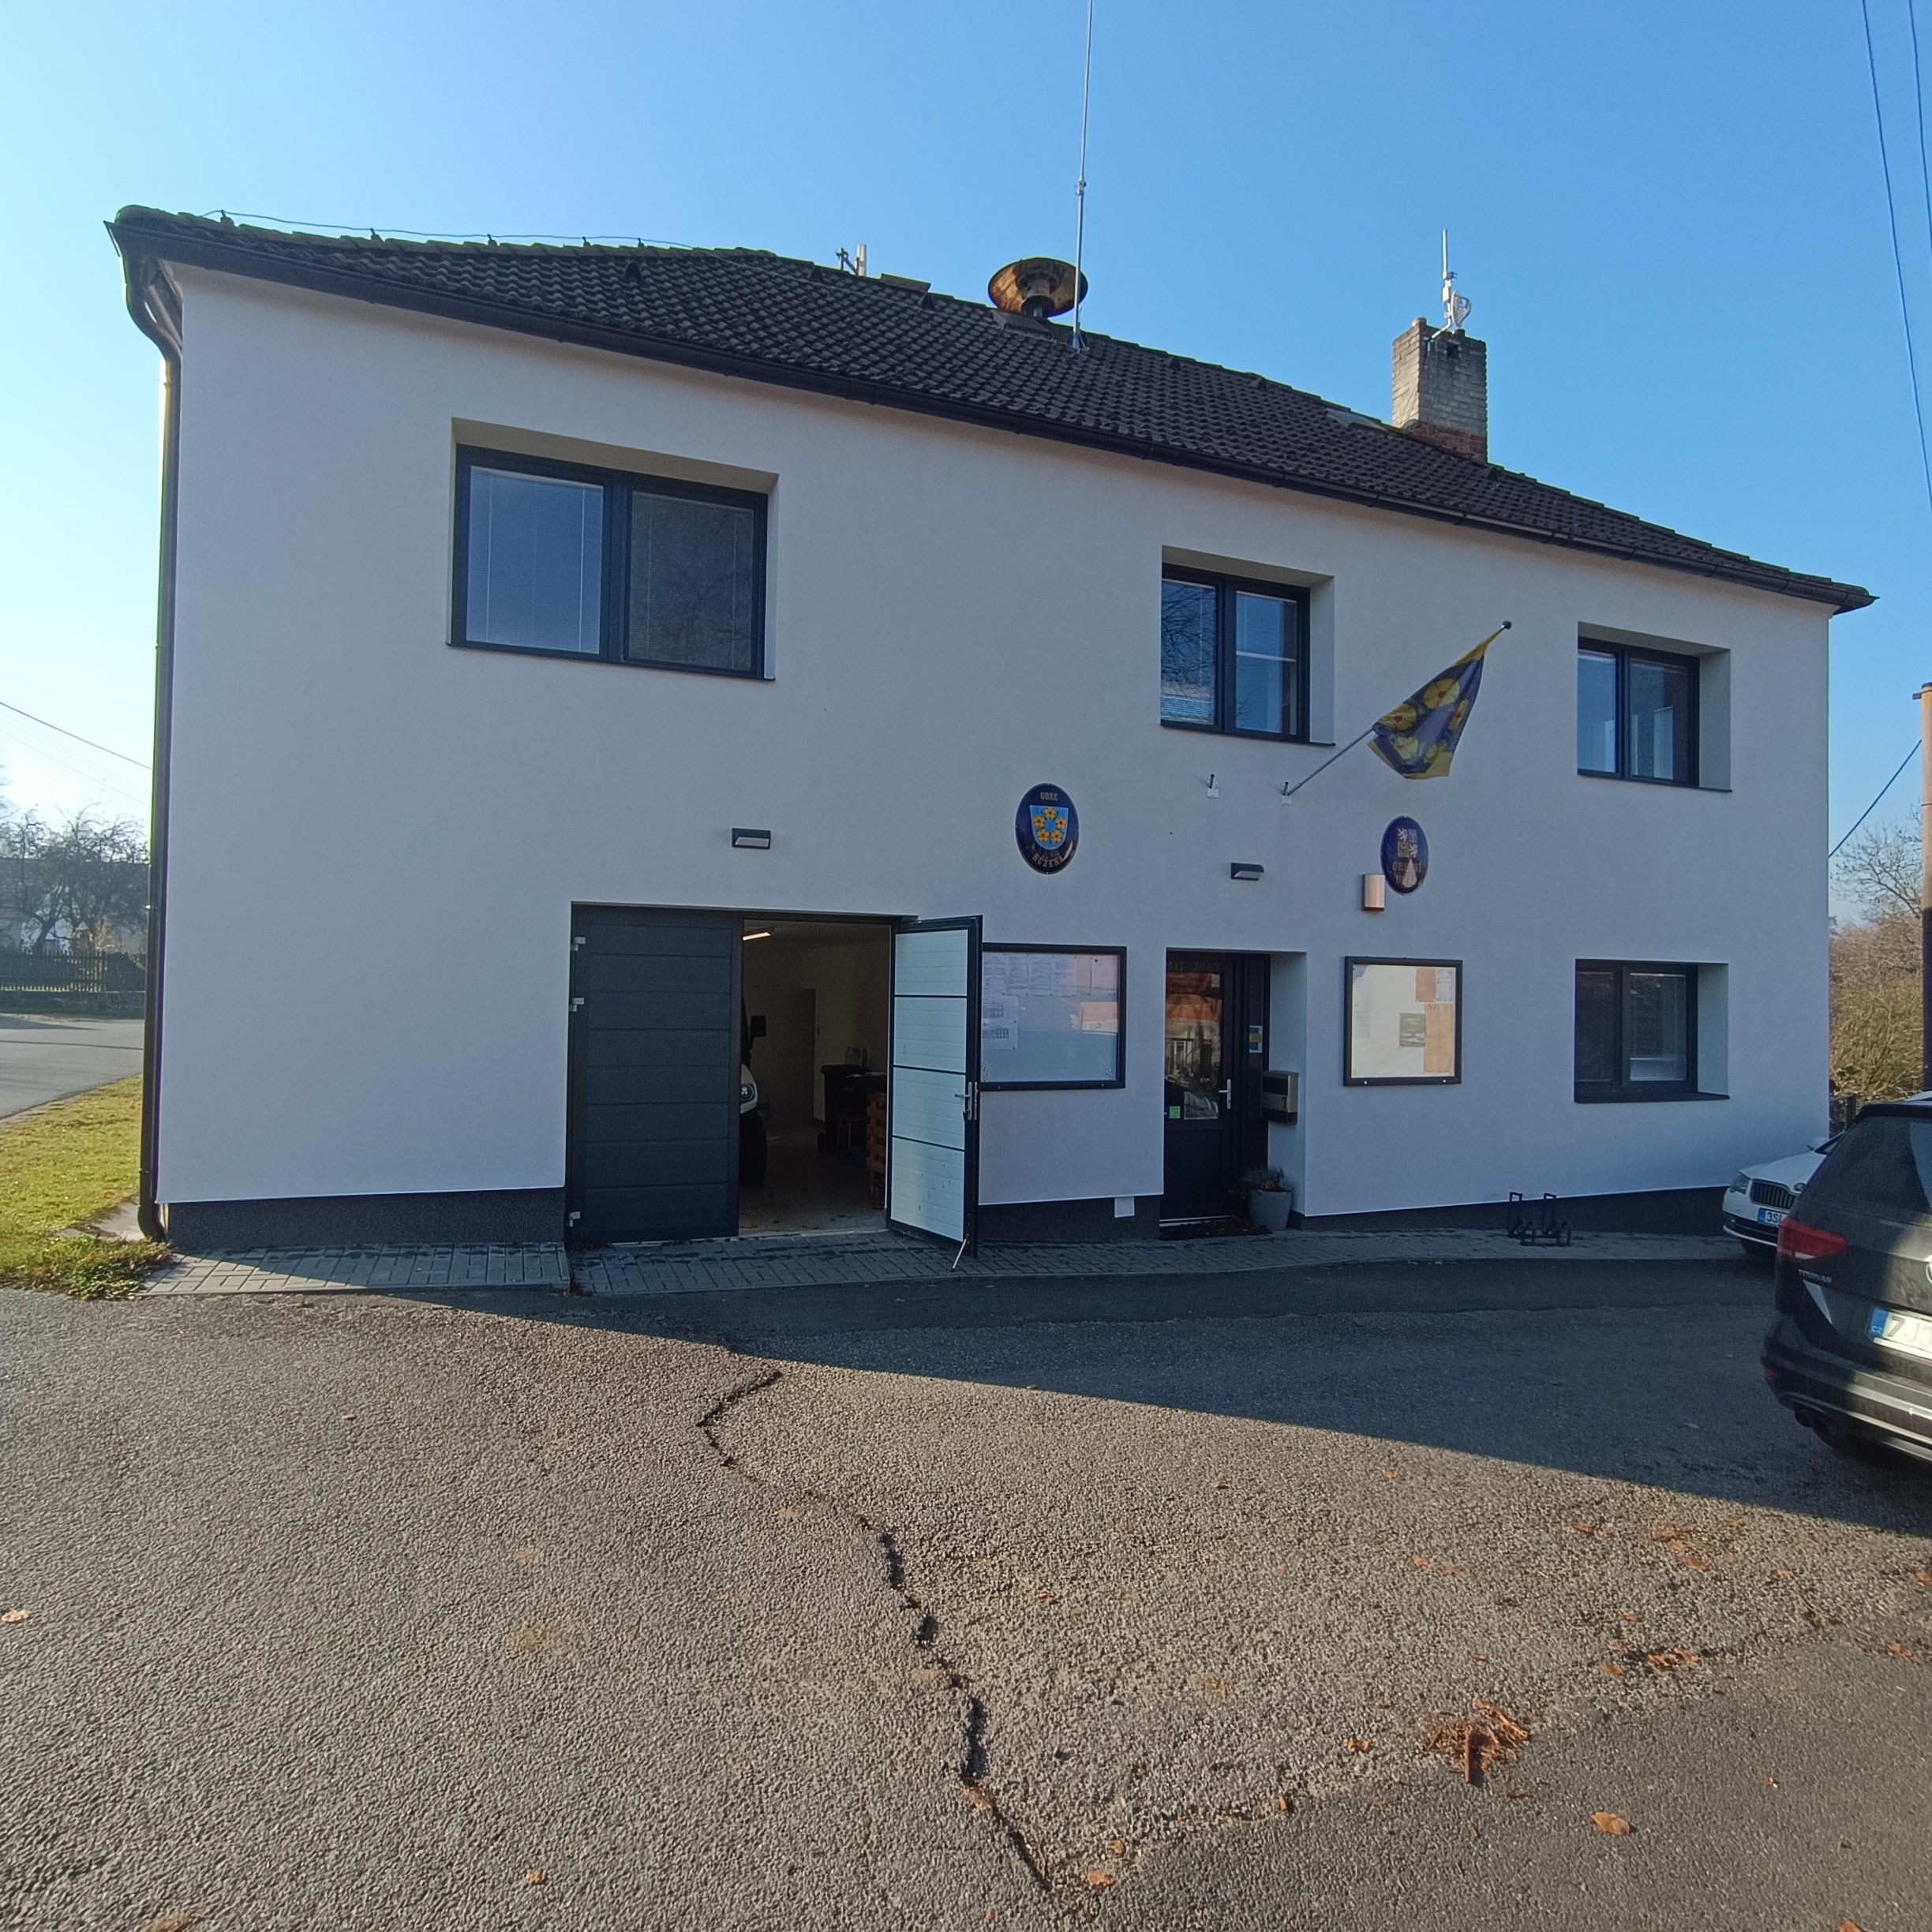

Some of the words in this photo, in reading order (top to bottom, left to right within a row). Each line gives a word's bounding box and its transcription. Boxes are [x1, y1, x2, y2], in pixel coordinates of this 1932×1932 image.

[1040, 792, 1058, 801] OBEC
[1032, 852, 1063, 867] RŮŽENA
[1392, 860, 1421, 873] OBENÍ
